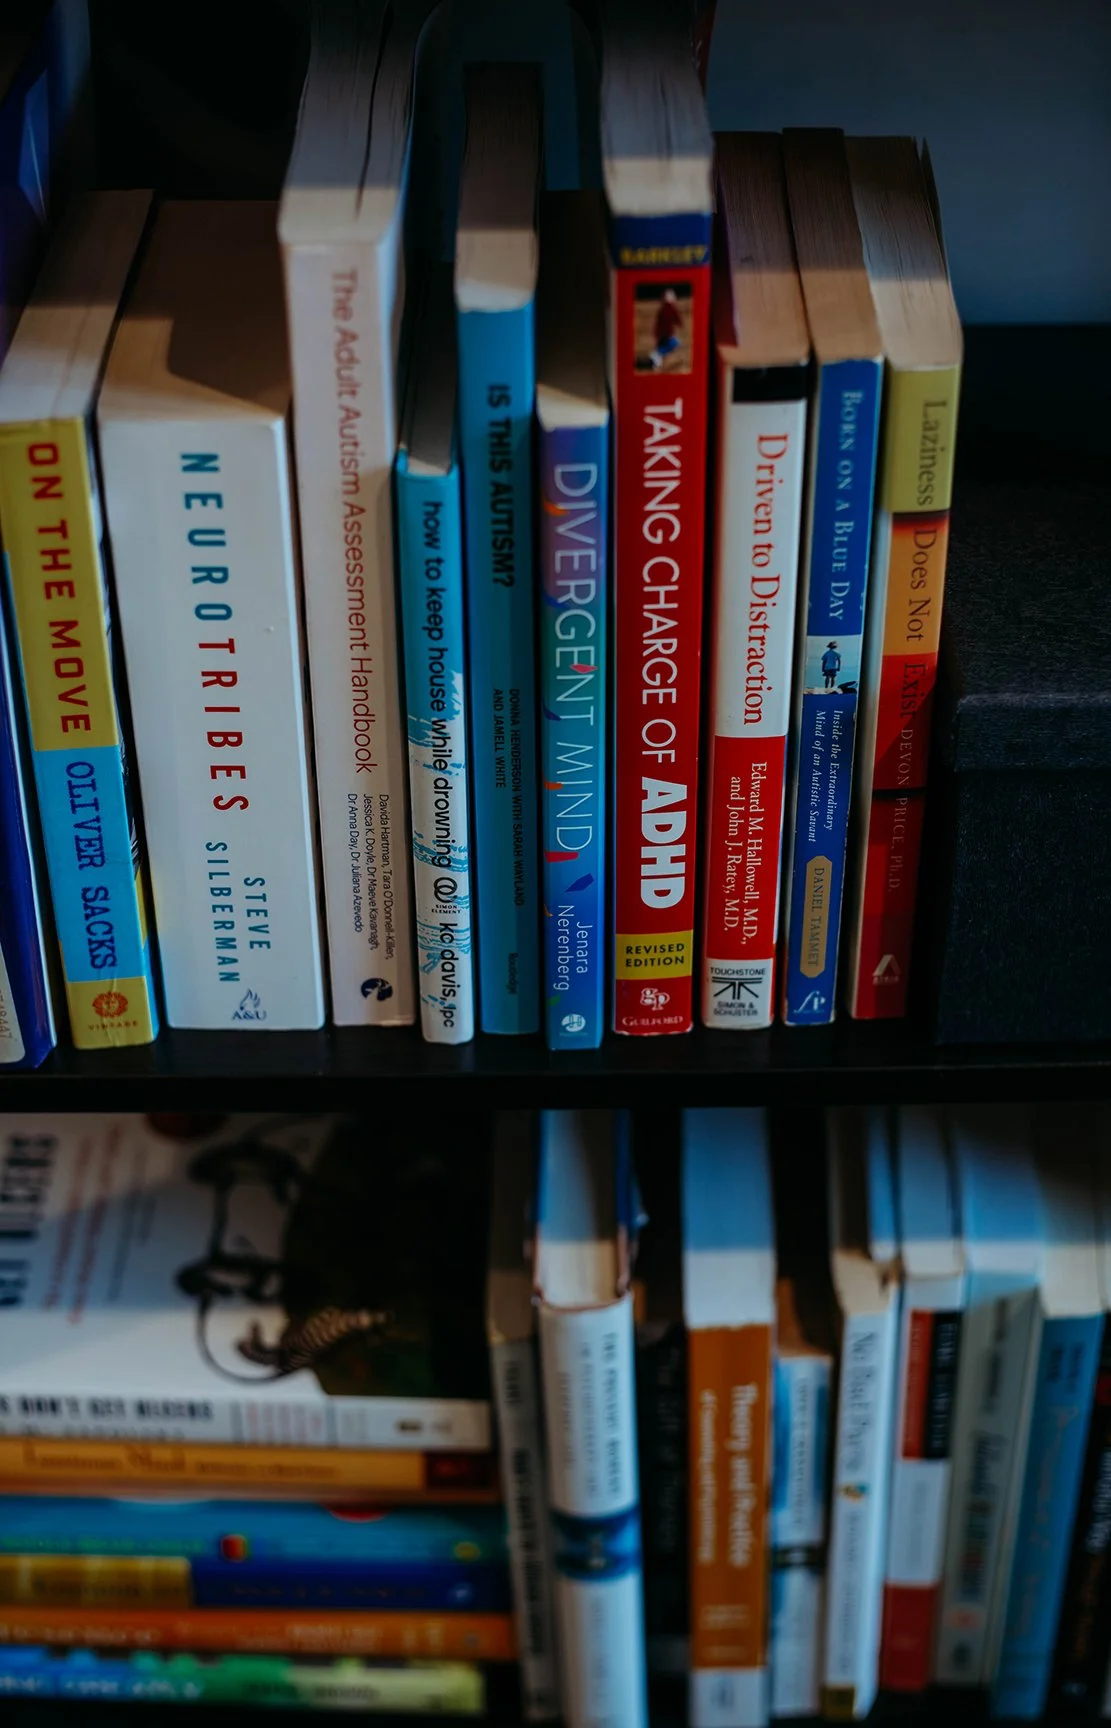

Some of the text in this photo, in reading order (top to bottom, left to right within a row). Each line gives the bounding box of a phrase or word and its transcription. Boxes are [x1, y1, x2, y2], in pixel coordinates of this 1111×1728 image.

[332, 270, 378, 774] The Adult Autism Assessment Handbook
[487, 384, 515, 588] IS THIS AUTISM?
[835, 499, 849, 512] A
[28, 442, 92, 733] ON THE MOVE
[554, 463, 598, 726] DIVERGENT
[743, 433, 789, 725] Driven to Distraction
[901, 400, 948, 718] Laziness Does Not Exist
[422, 501, 456, 868] how to keep house while drowning
[640, 397, 688, 909] TAKING CHARGE OF ADHD
[493, 688, 506, 788] AND JAMELL WHITE
[808, 710, 826, 842] Mind of an Autistic Savant
[824, 710, 844, 831] Inside the Extraordinary
[897, 728, 913, 787] DEVON
[379, 794, 390, 826] Davida
[509, 688, 525, 906] DONNA HENDERSON WITH SARAH WAYLAND
[556, 742, 594, 850] MIND
[65, 761, 118, 970] OLIVER SACKS
[347, 793, 364, 933] Dr Anna Day, Dr Juliana Azevedo
[363, 793, 380, 951] Jessica K. Doyle, Dr Maeve Kavanagh,
[381, 827, 393, 868] Hartman,
[383, 870, 393, 890] Tara
[722, 776, 746, 932] and John J. Ratey, M.D.
[741, 761, 768, 945] Edward M. Hallowell, M.D.,
[205, 841, 240, 982] SILBERMAN
[243, 877, 271, 949] STEVE
[439, 923, 458, 944] kc
[553, 904, 575, 991] Nerenberg
[576, 921, 593, 974] Jenara
[625, 955, 685, 968] EDITION
[626, 943, 685, 956] REVISED
[807, 867, 825, 967] DANIEL TAMMET
[231, 1010, 267, 1021] A&U
[710, 967, 766, 976] TOUCHSTONE
[713, 1008, 759, 1017] SCHUSTER
[717, 1001, 746, 1009] SIMON
[87, 1020, 138, 1031] VINTAGE
[724, 1382, 760, 1452] Theory
